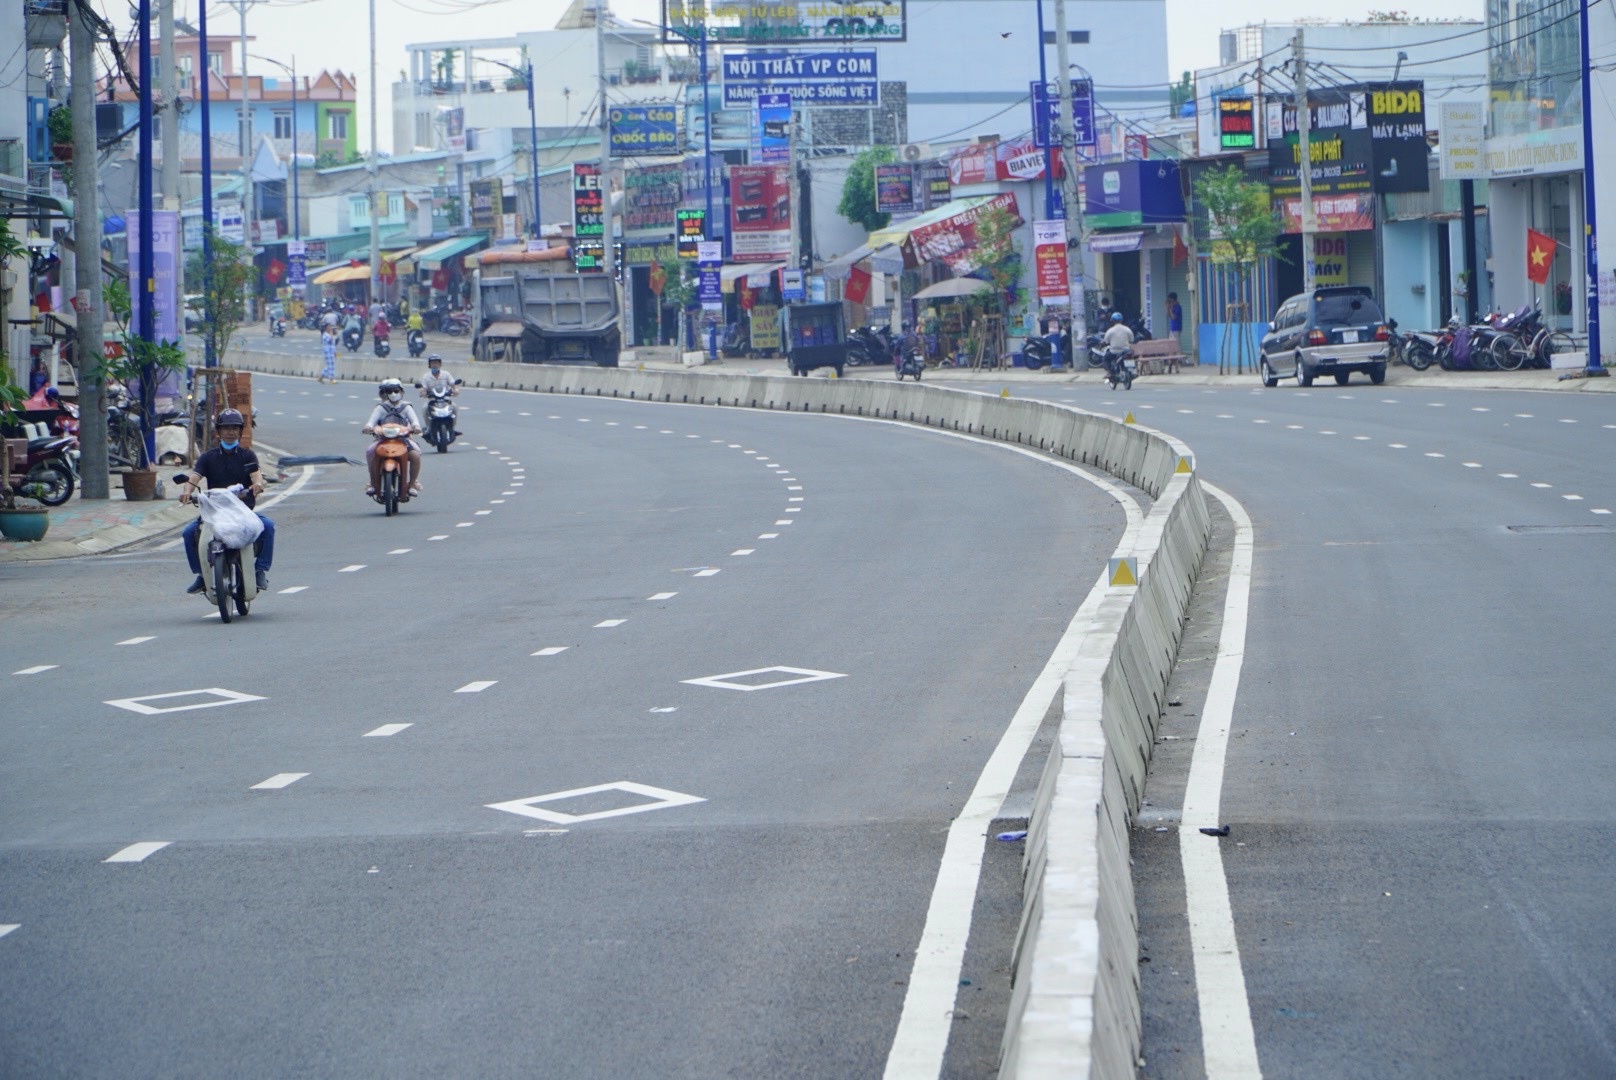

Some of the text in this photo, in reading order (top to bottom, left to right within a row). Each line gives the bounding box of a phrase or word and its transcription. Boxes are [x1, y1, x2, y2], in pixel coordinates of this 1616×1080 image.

[771, 7, 797, 18] LED
[729, 54, 873, 79] NỘI THẤT VP COM
[729, 84, 759, 99] NÂNG
[818, 83, 847, 99] SỐNG
[850, 84, 874, 100] VIỆT
[1373, 90, 1422, 115] BIDA
[612, 128, 647, 145] QUỐC
[1373, 122, 1423, 141] MÁY LẠNH
[1010, 160, 1027, 173] BIA
[1316, 238, 1346, 256] IDA
